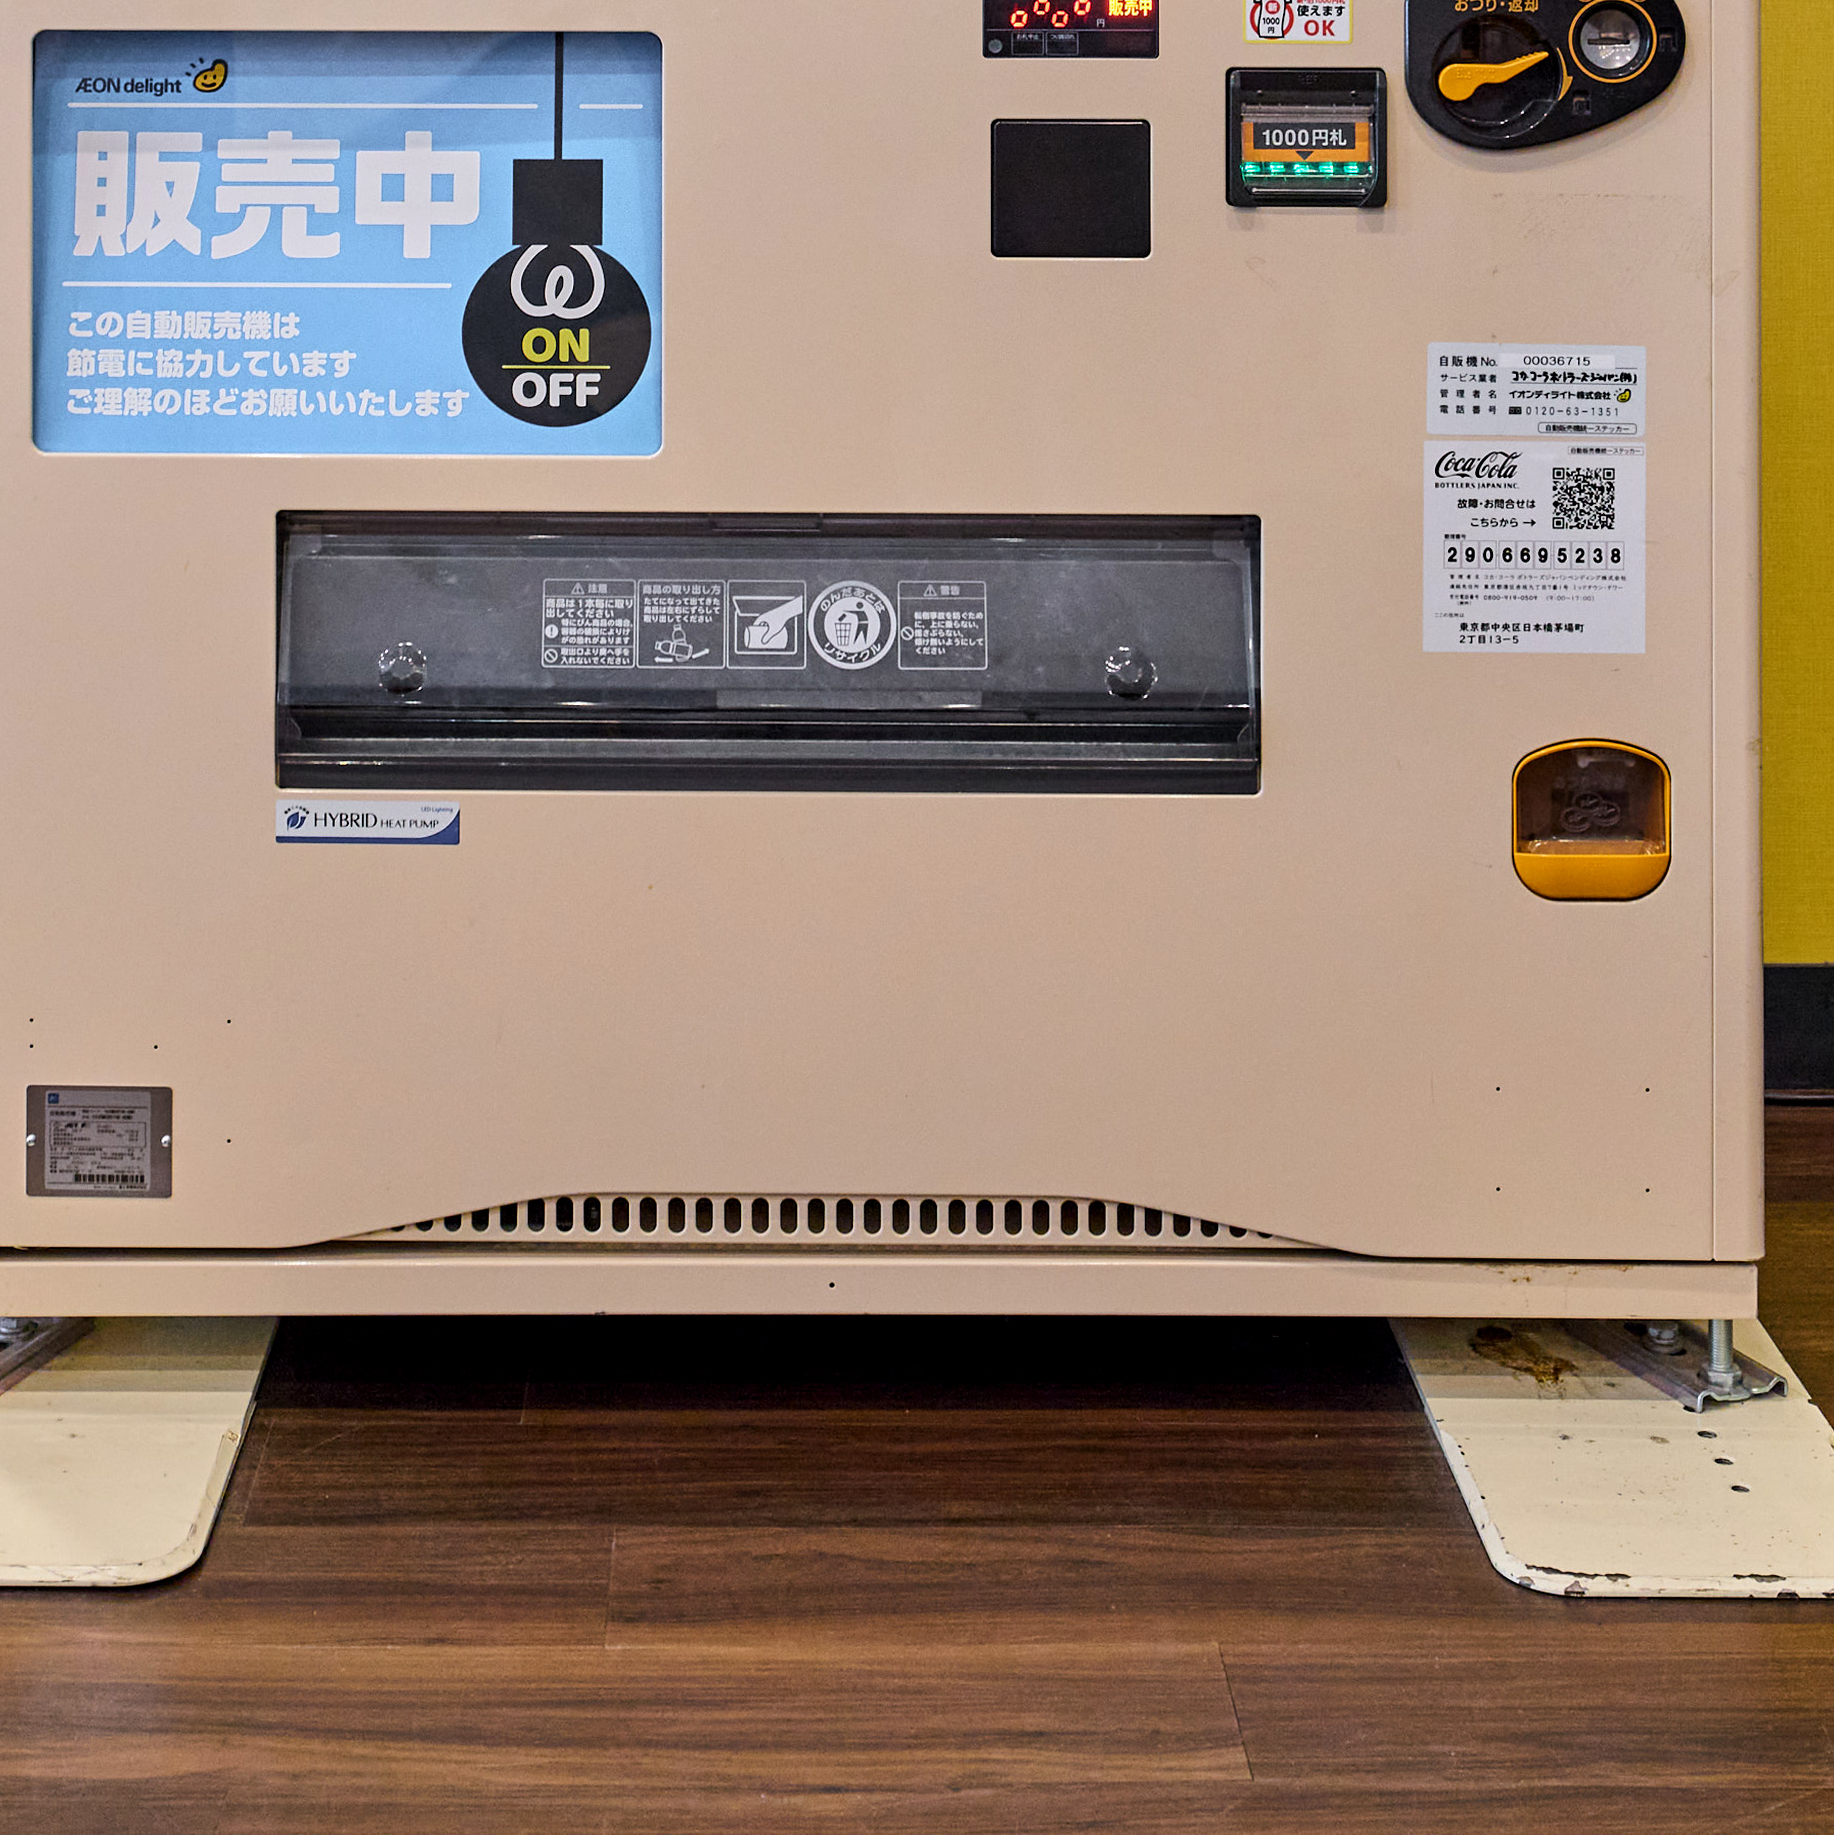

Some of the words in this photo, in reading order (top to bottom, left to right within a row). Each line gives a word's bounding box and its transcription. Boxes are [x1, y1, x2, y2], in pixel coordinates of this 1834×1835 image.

[1297, 5, 1345, 16] 使えます
[1096, 18, 1105, 27] 円
[1304, 20, 1335, 36] OK
[123, 77, 182, 97] delight
[1261, 128, 1348, 149] 1000円札
[73, 130, 481, 259] 販売中
[68, 310, 301, 341] この自動販売機は
[521, 326, 590, 364] ON
[66, 350, 357, 379] 節電に協力しています
[1524, 356, 1591, 366] 00036715
[511, 372, 602, 409] OFF
[1509, 391, 1611, 400] イオンディライト株式会社
[66, 389, 471, 418] ご理解のほどお願いいたします
[1526, 406, 1619, 416] 0120-63-1351
[1435, 451, 1523, 479] Coca-Cola
[1458, 499, 1536, 509] 故障・お問合せは
[1471, 518, 1519, 528] こちらから
[643, 585, 721, 595] 商品の取り出し方
[1459, 623, 1584, 632] 東京都中央区日本橋茅場町
[314, 812, 377, 828] HYBRID
[381, 820, 405, 828] HEAT
[409, 820, 439, 828] PUMP
